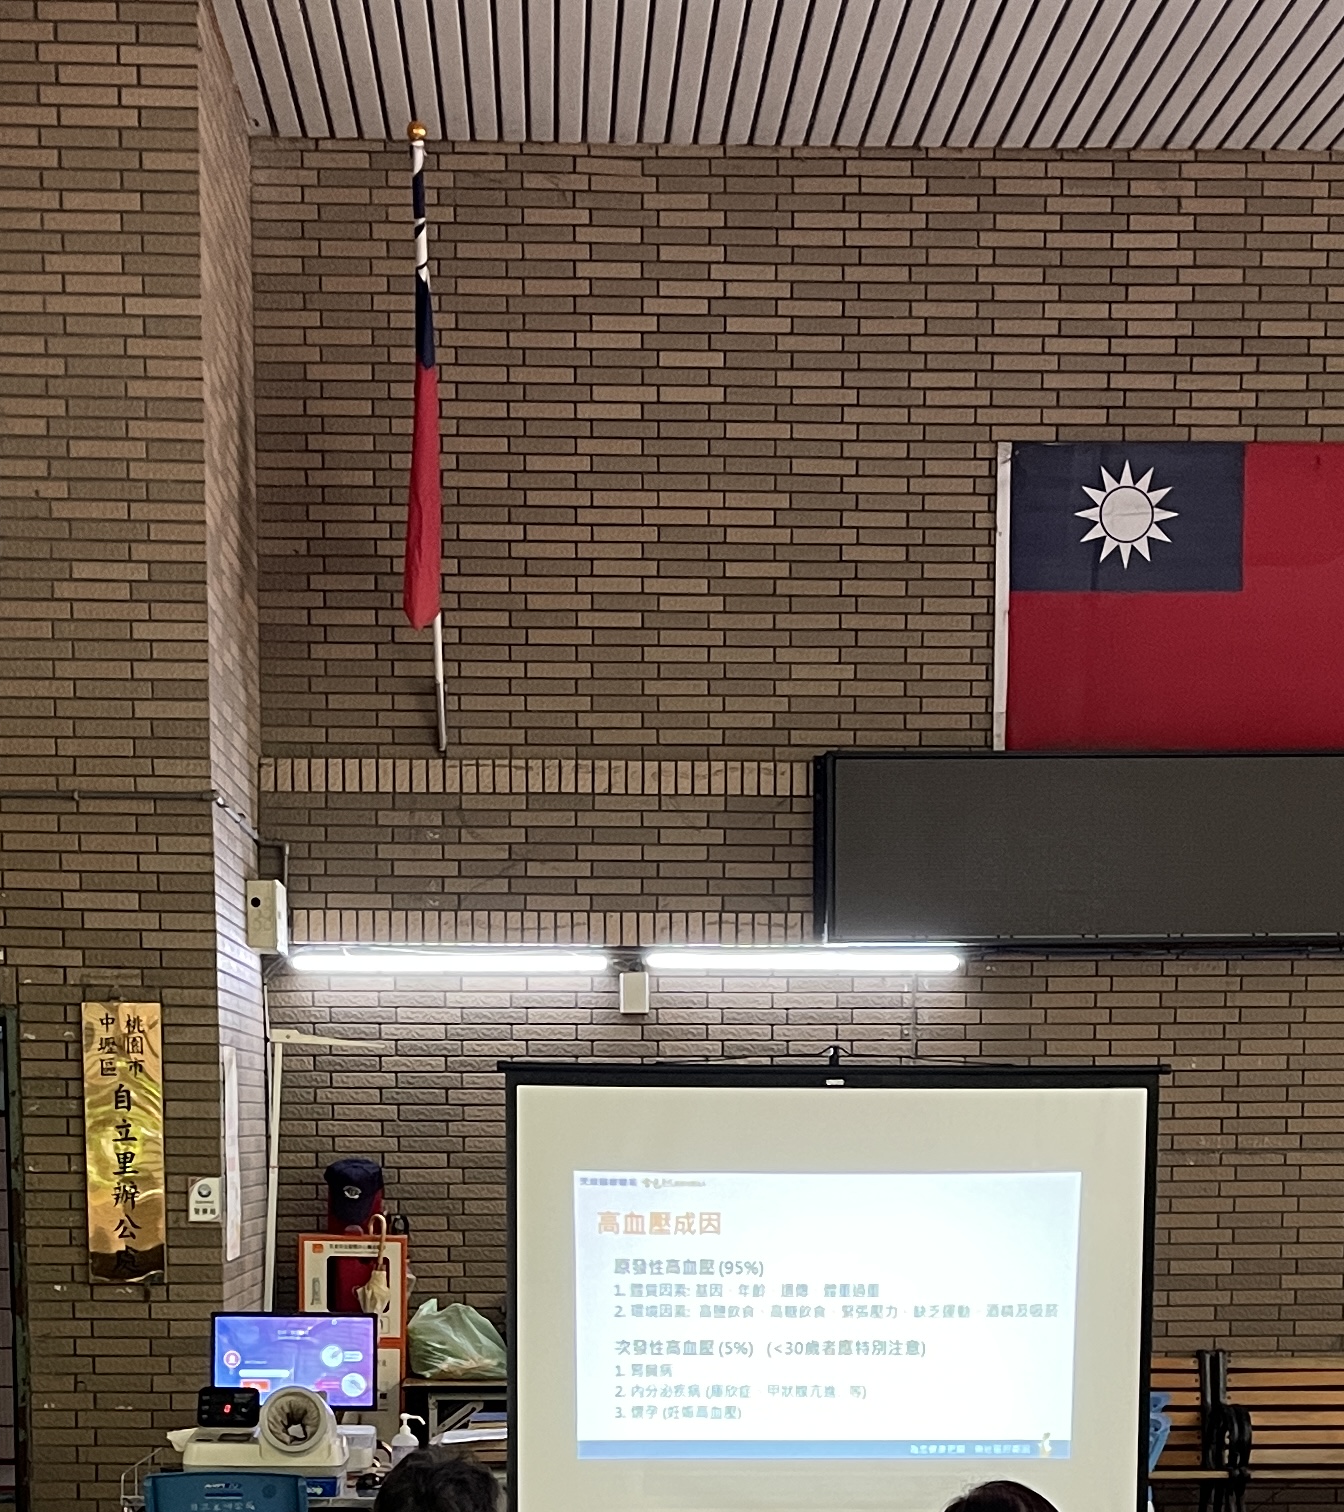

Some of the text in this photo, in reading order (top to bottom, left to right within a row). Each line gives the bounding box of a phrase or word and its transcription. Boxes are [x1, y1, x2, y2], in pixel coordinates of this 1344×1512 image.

[98, 1012, 118, 1077] 中壢區
[124, 1014, 146, 1078] 桃園市
[111, 1084, 142, 1273] 自立里辦公處
[597, 1210, 722, 1236] 高血壓成因
[613, 1258, 764, 1277] 原發性高血壓 (95%)
[614, 1284, 626, 1297] 1.
[614, 1305, 626, 1318] 2.
[614, 1339, 715, 1356] 次發性高血壓
[718, 1341, 754, 1358] (5%)
[615, 1365, 626, 1377] 1.
[615, 1385, 626, 1398] 2.
[615, 1405, 626, 1418] 3.
